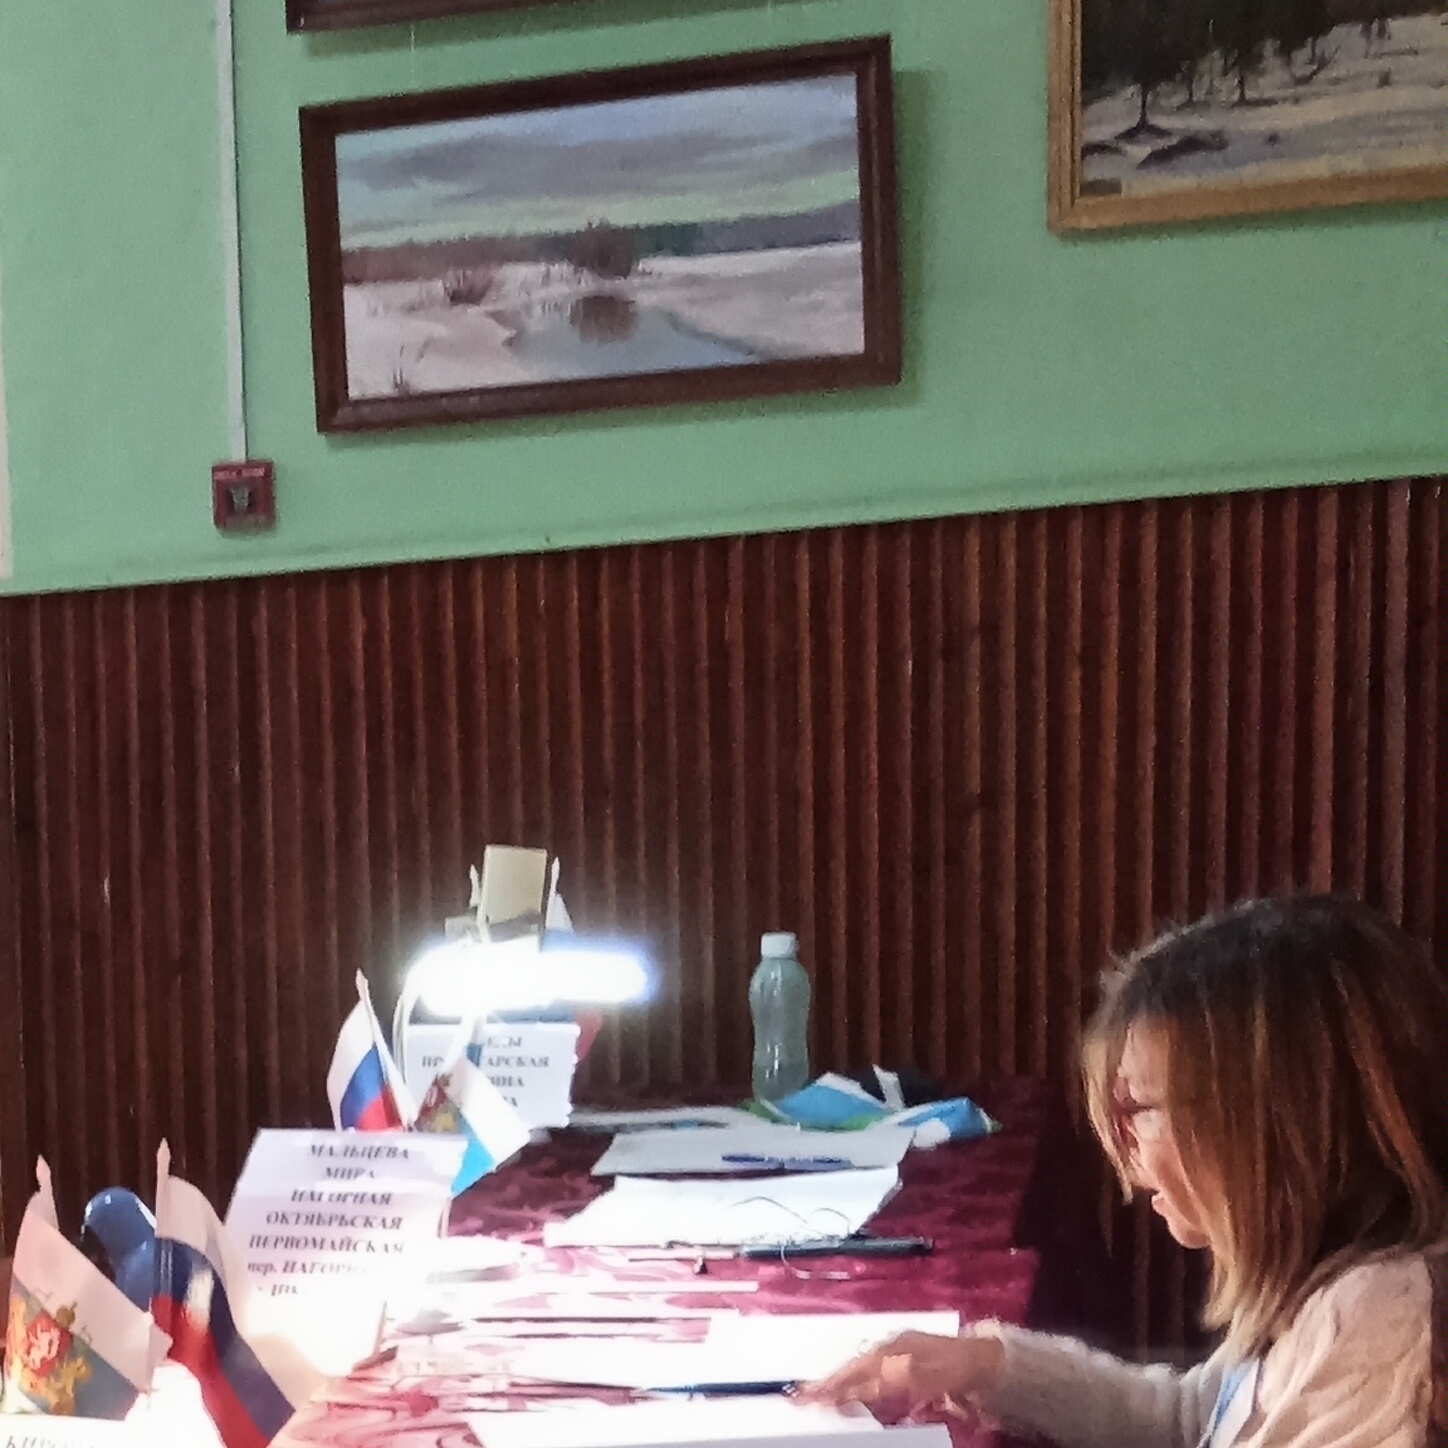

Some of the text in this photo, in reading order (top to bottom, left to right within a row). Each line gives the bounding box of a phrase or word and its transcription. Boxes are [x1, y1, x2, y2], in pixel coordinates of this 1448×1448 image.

[307, 1144, 410, 1161] МАЛЬЦЕВА
[323, 1166, 376, 1180] МИРА
[266, 1210, 404, 1230] ОКТЯБРЬСКАЯ
[247, 1233, 405, 1255] ПЕРВОМАЙСКАЯ
